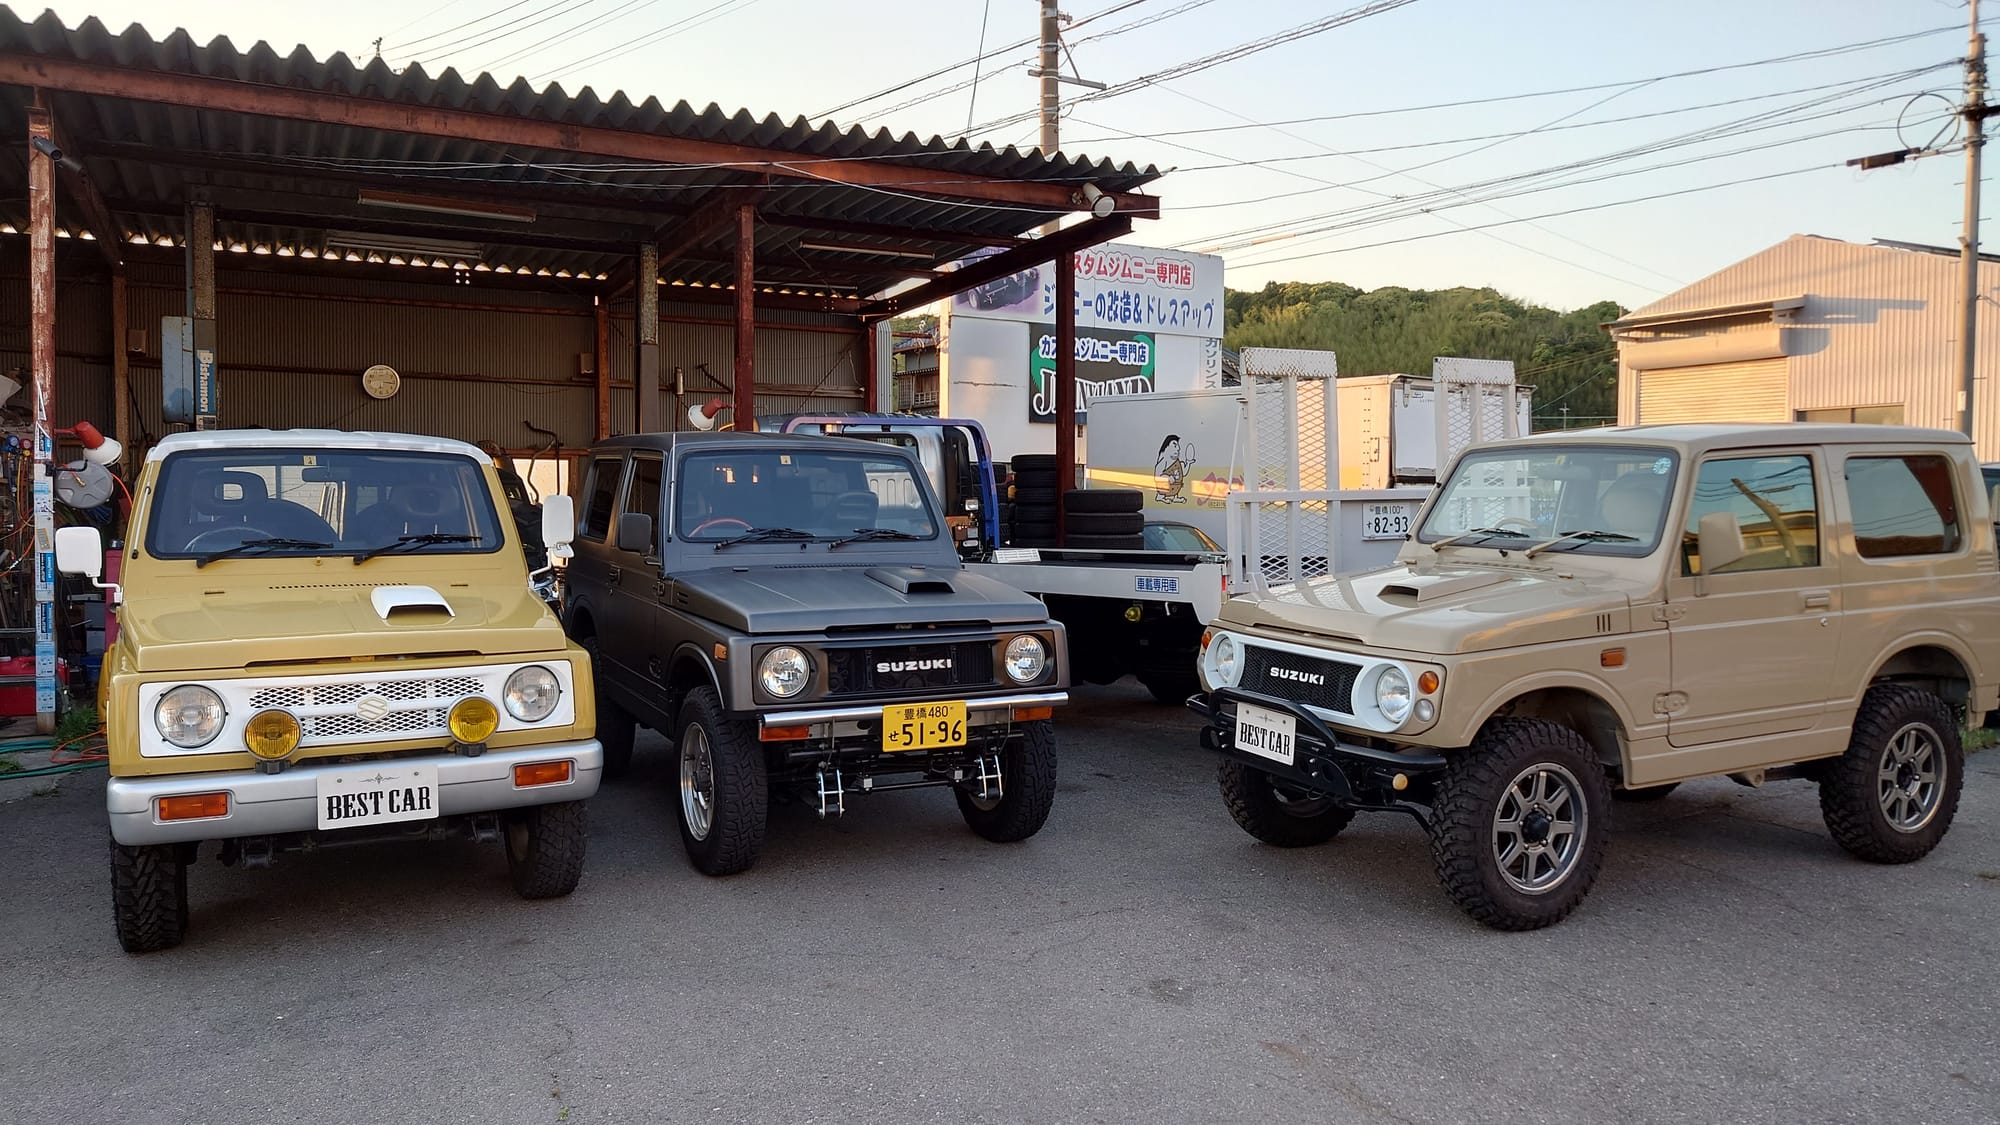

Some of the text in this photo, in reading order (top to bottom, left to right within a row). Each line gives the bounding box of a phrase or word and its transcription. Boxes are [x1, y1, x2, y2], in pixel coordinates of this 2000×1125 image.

[1074, 253, 1191, 286] スタムジムニー専門店
[1041, 337, 1147, 363] カスムジムニー専門店
[199, 351, 214, 413] Bishamon
[1374, 516, 1409, 534] 82-93
[876, 658, 952, 673] SUZUKI
[1270, 666, 1325, 686] SUZUKI
[904, 705, 949, 720] 豊橋 480
[888, 719, 962, 746] せ 51-96
[1240, 722, 1290, 757] BEST CAR
[326, 786, 431, 820] BEST CAR
